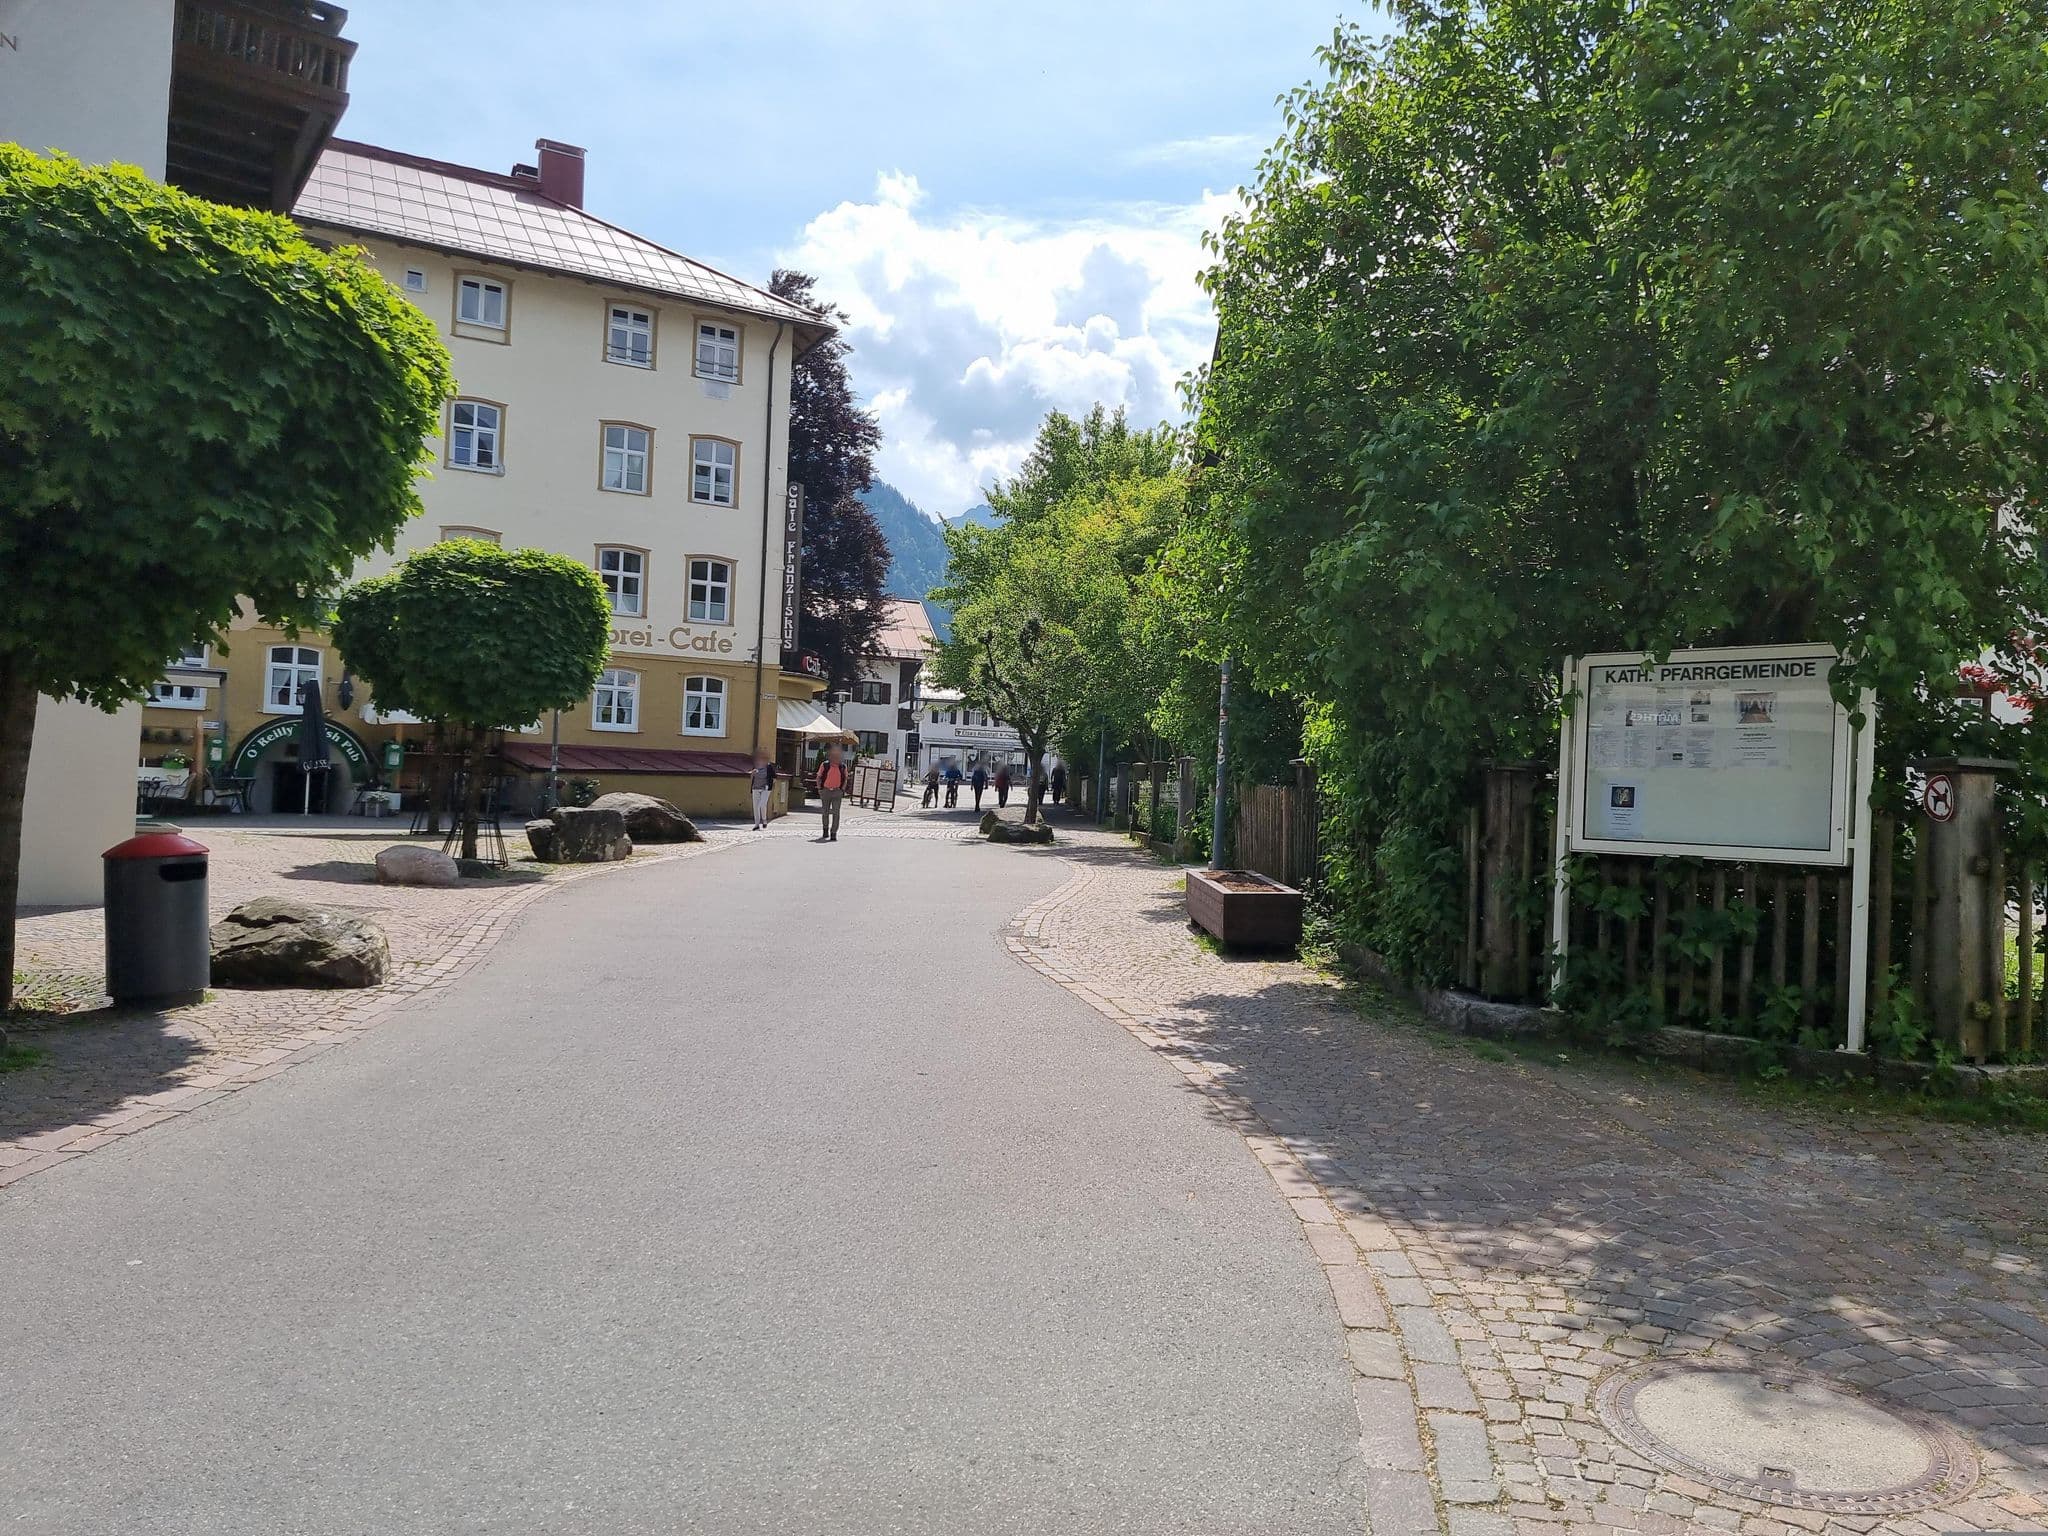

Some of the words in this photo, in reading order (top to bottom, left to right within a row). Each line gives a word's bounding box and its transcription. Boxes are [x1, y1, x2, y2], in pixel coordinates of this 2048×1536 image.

[1605, 668, 1653, 683] KATH.
[1660, 662, 1817, 682] PFARRGEMEINDE
[341, 740, 360, 761] Pub
